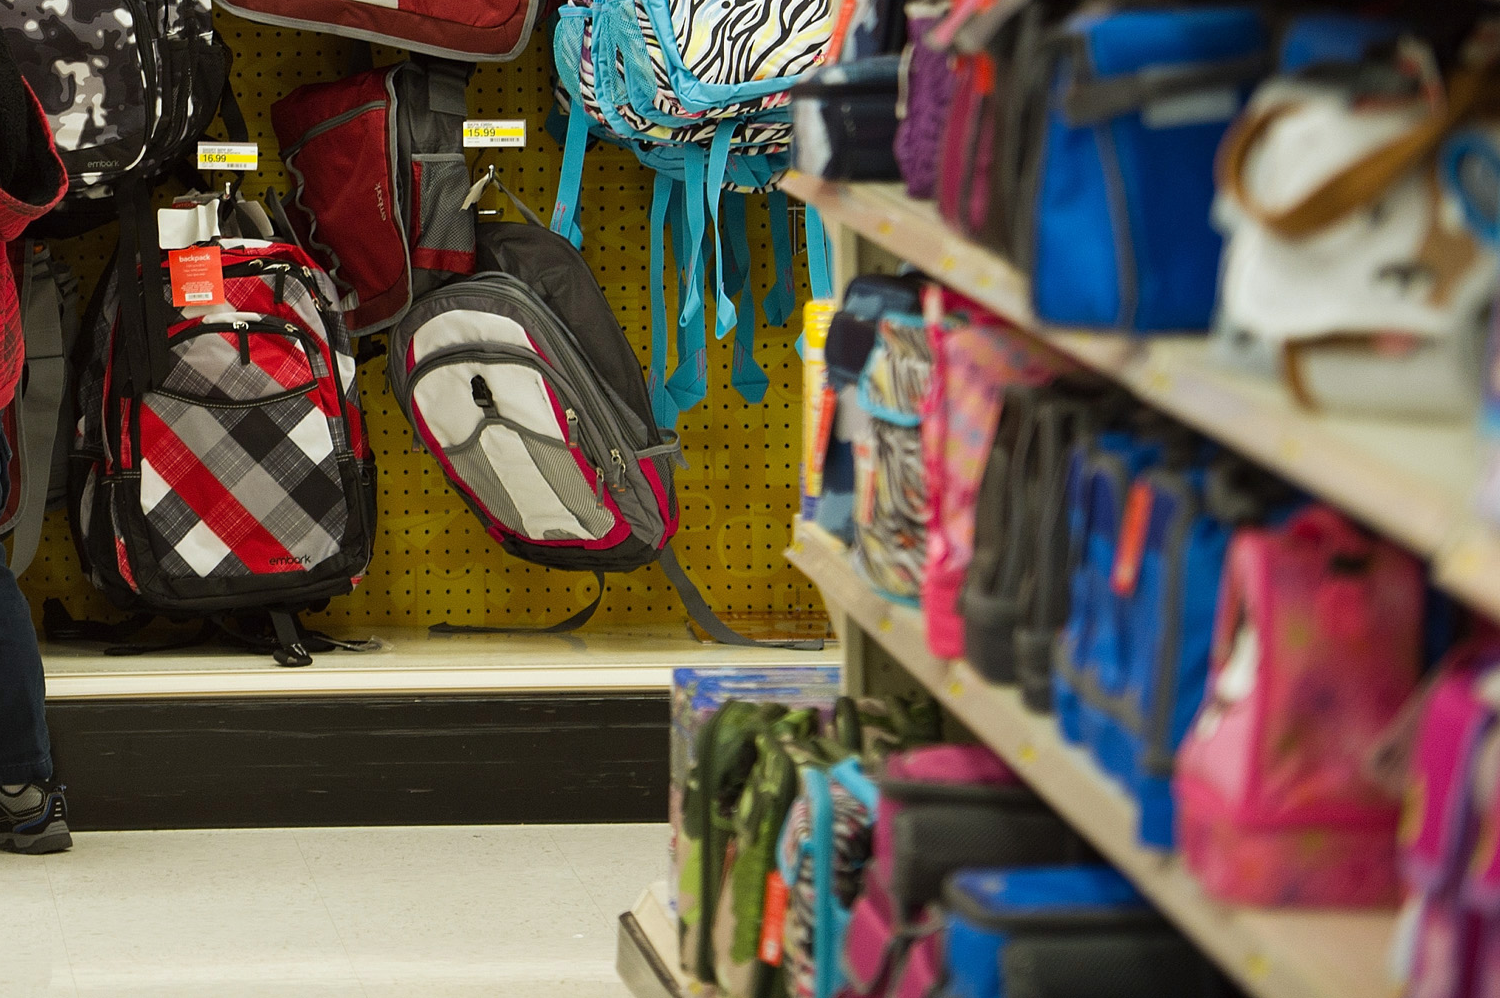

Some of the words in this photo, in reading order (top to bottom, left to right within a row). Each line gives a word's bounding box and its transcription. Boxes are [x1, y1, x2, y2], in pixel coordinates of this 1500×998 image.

[468, 128, 496, 137] 15.99
[202, 154, 226, 162] 16.99
[87, 160, 120, 168] embark
[374, 182, 387, 221] embark
[178, 253, 211, 263] backpack
[269, 554, 311, 566] embark
